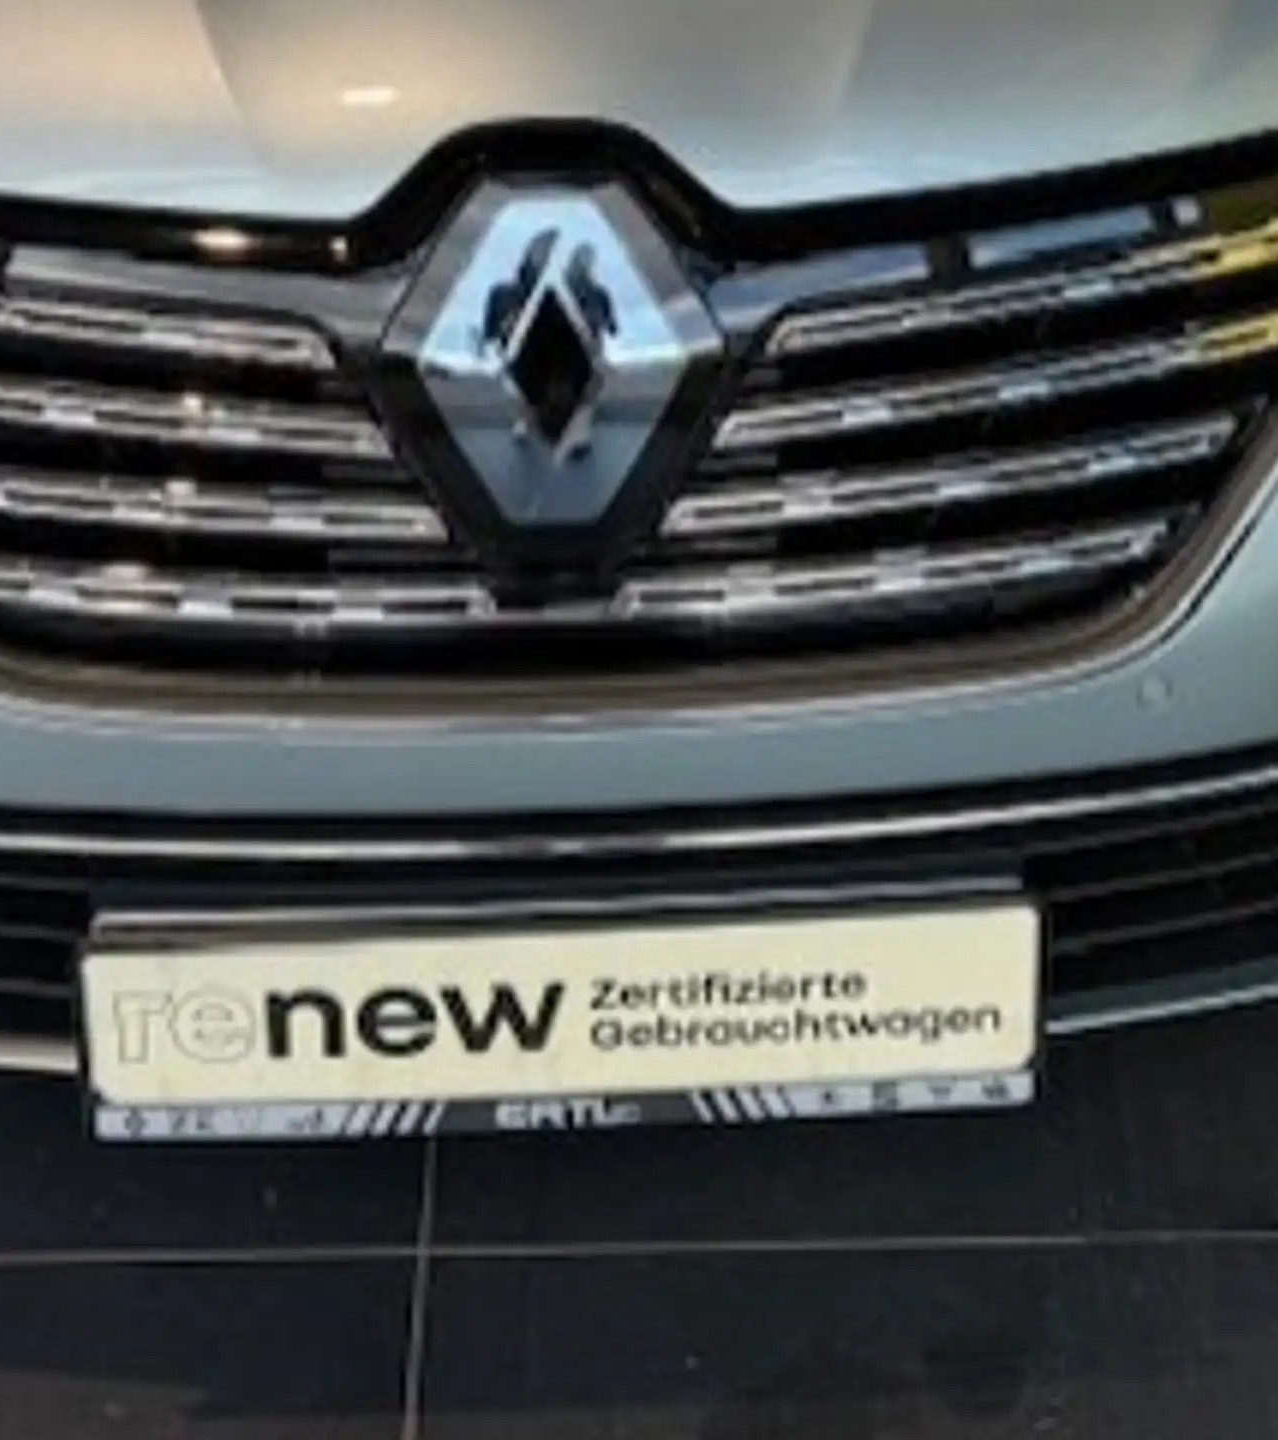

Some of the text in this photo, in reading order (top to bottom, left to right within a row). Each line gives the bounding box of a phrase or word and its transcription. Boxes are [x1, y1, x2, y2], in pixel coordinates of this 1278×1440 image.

[589, 970, 868, 1012] Zertifizierte
[113, 980, 565, 1064] renew
[589, 1003, 1003, 1052] Gebrauchtwagen
